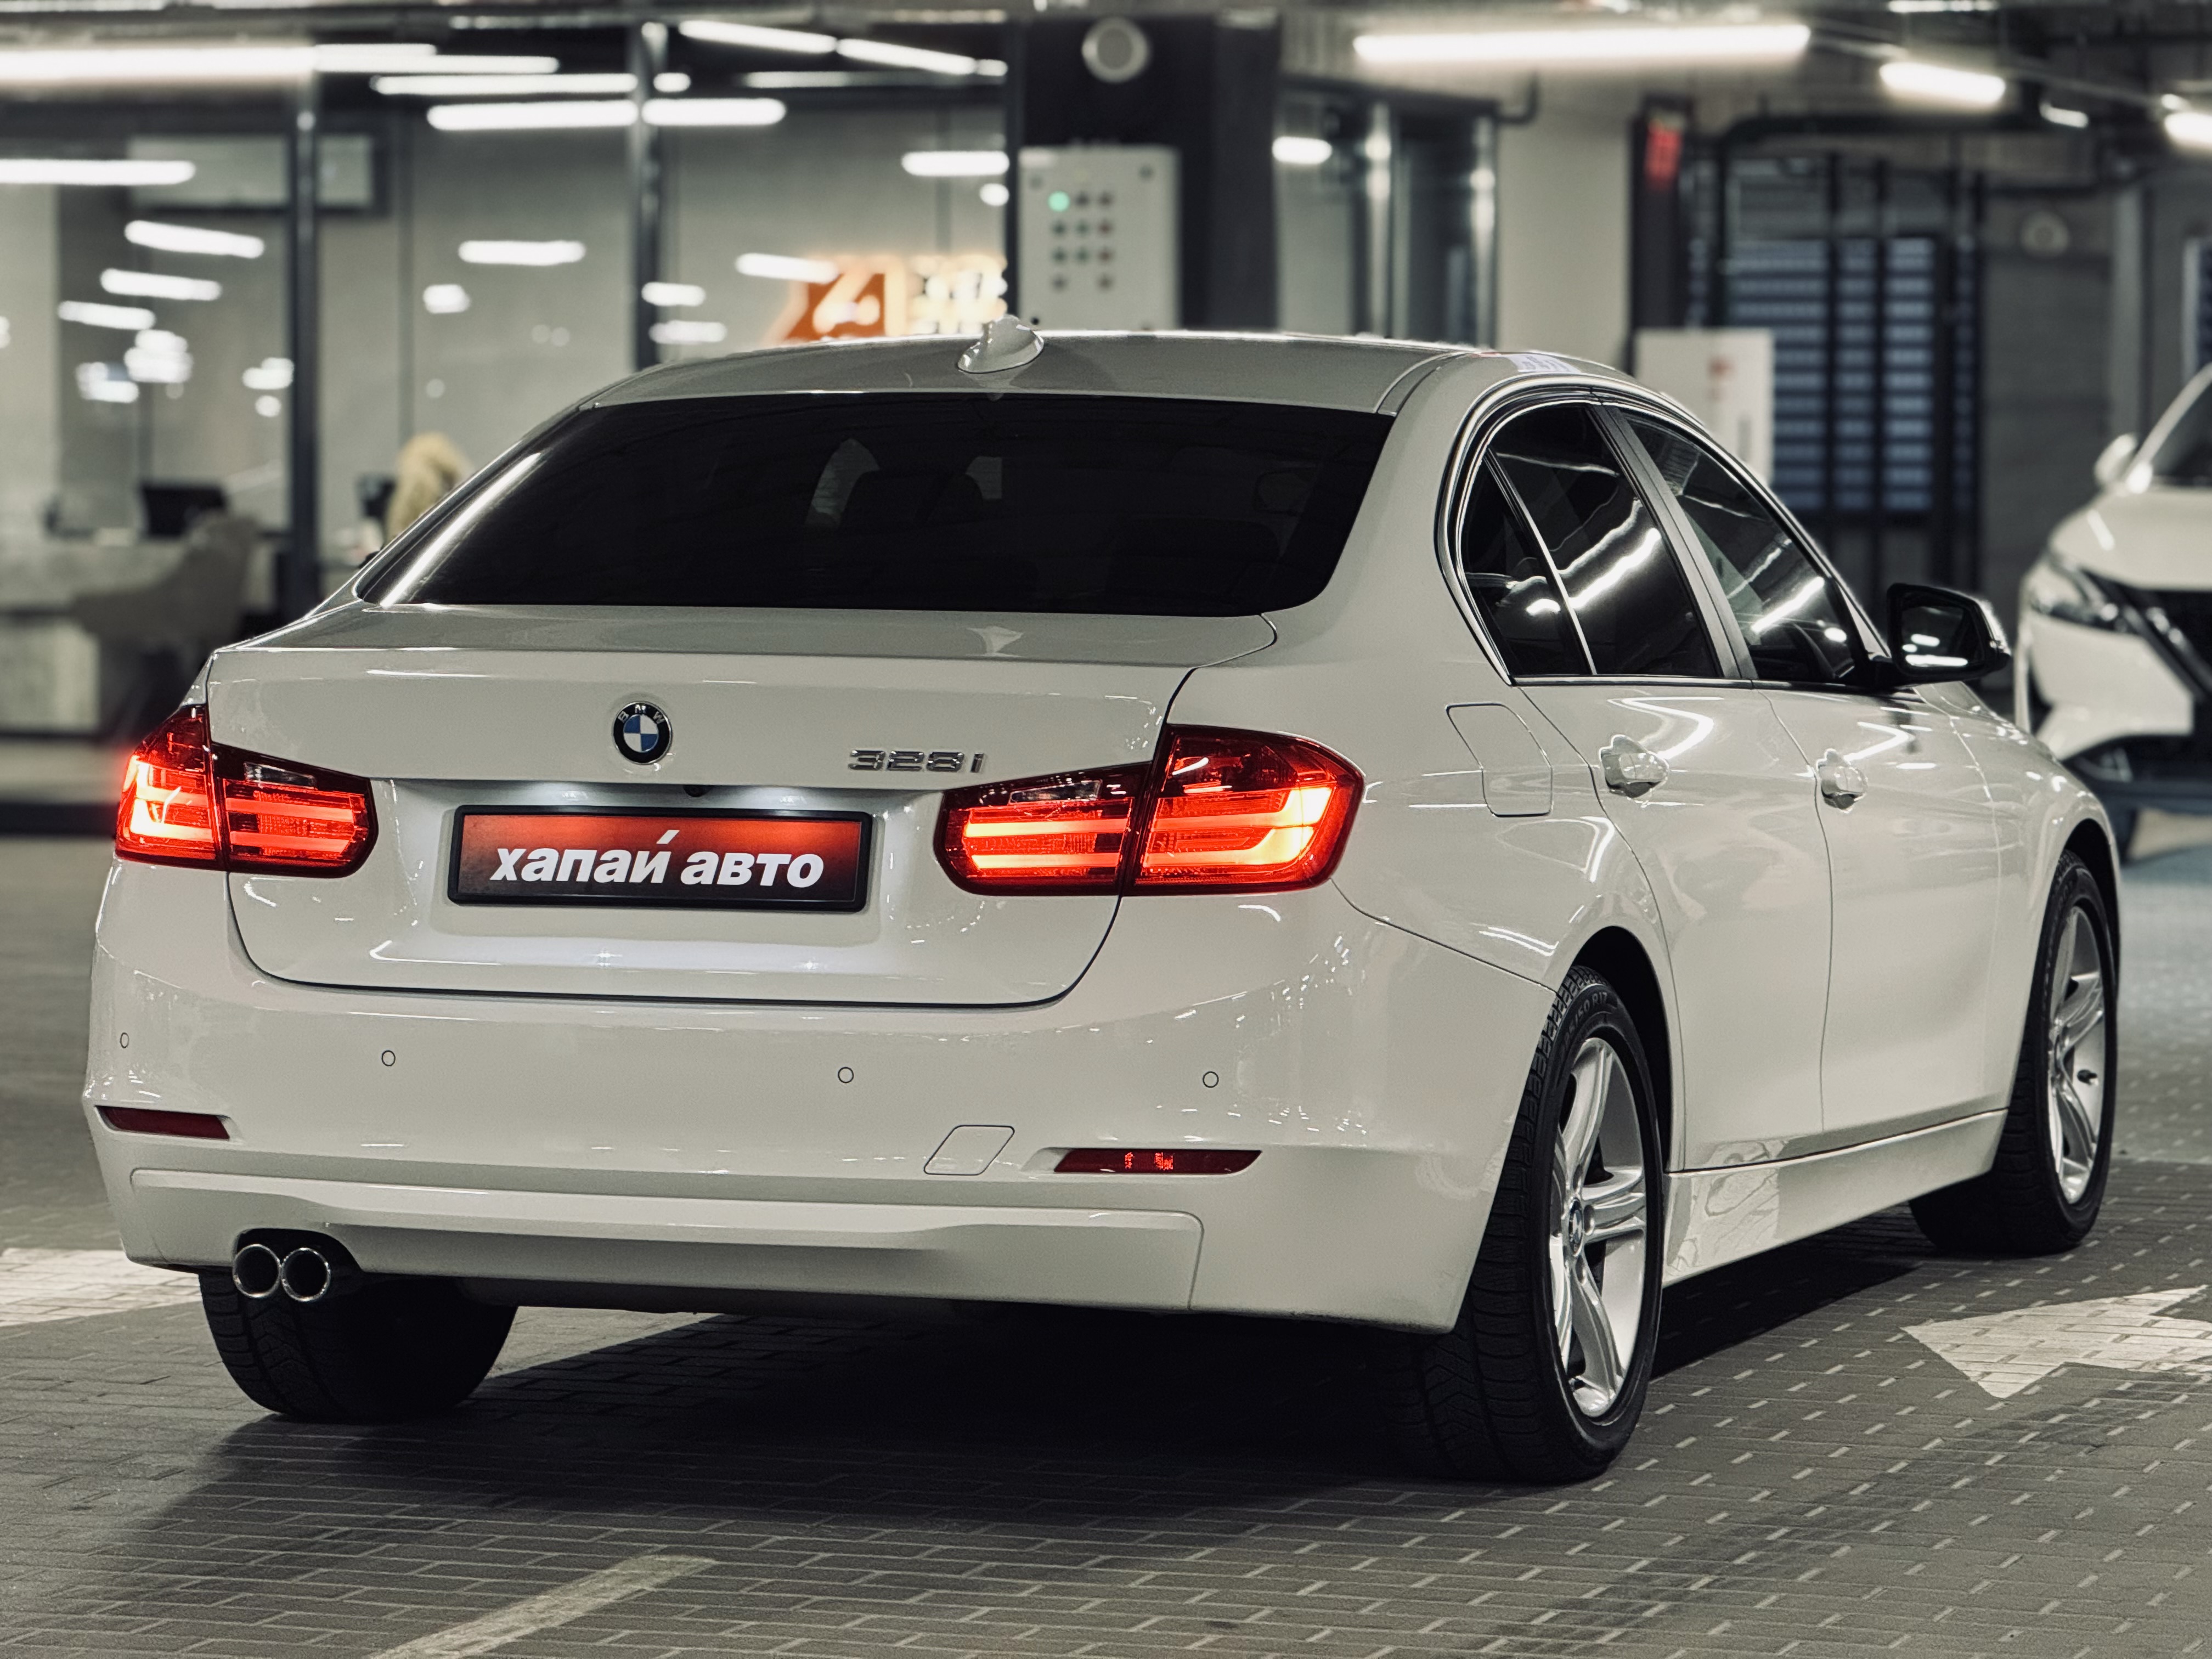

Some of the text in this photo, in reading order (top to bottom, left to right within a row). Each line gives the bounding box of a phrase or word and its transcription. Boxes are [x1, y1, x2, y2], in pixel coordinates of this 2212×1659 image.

[617, 704, 665, 724] BMW
[848, 749, 984, 773] 328i
[680, 851, 824, 888] авто
